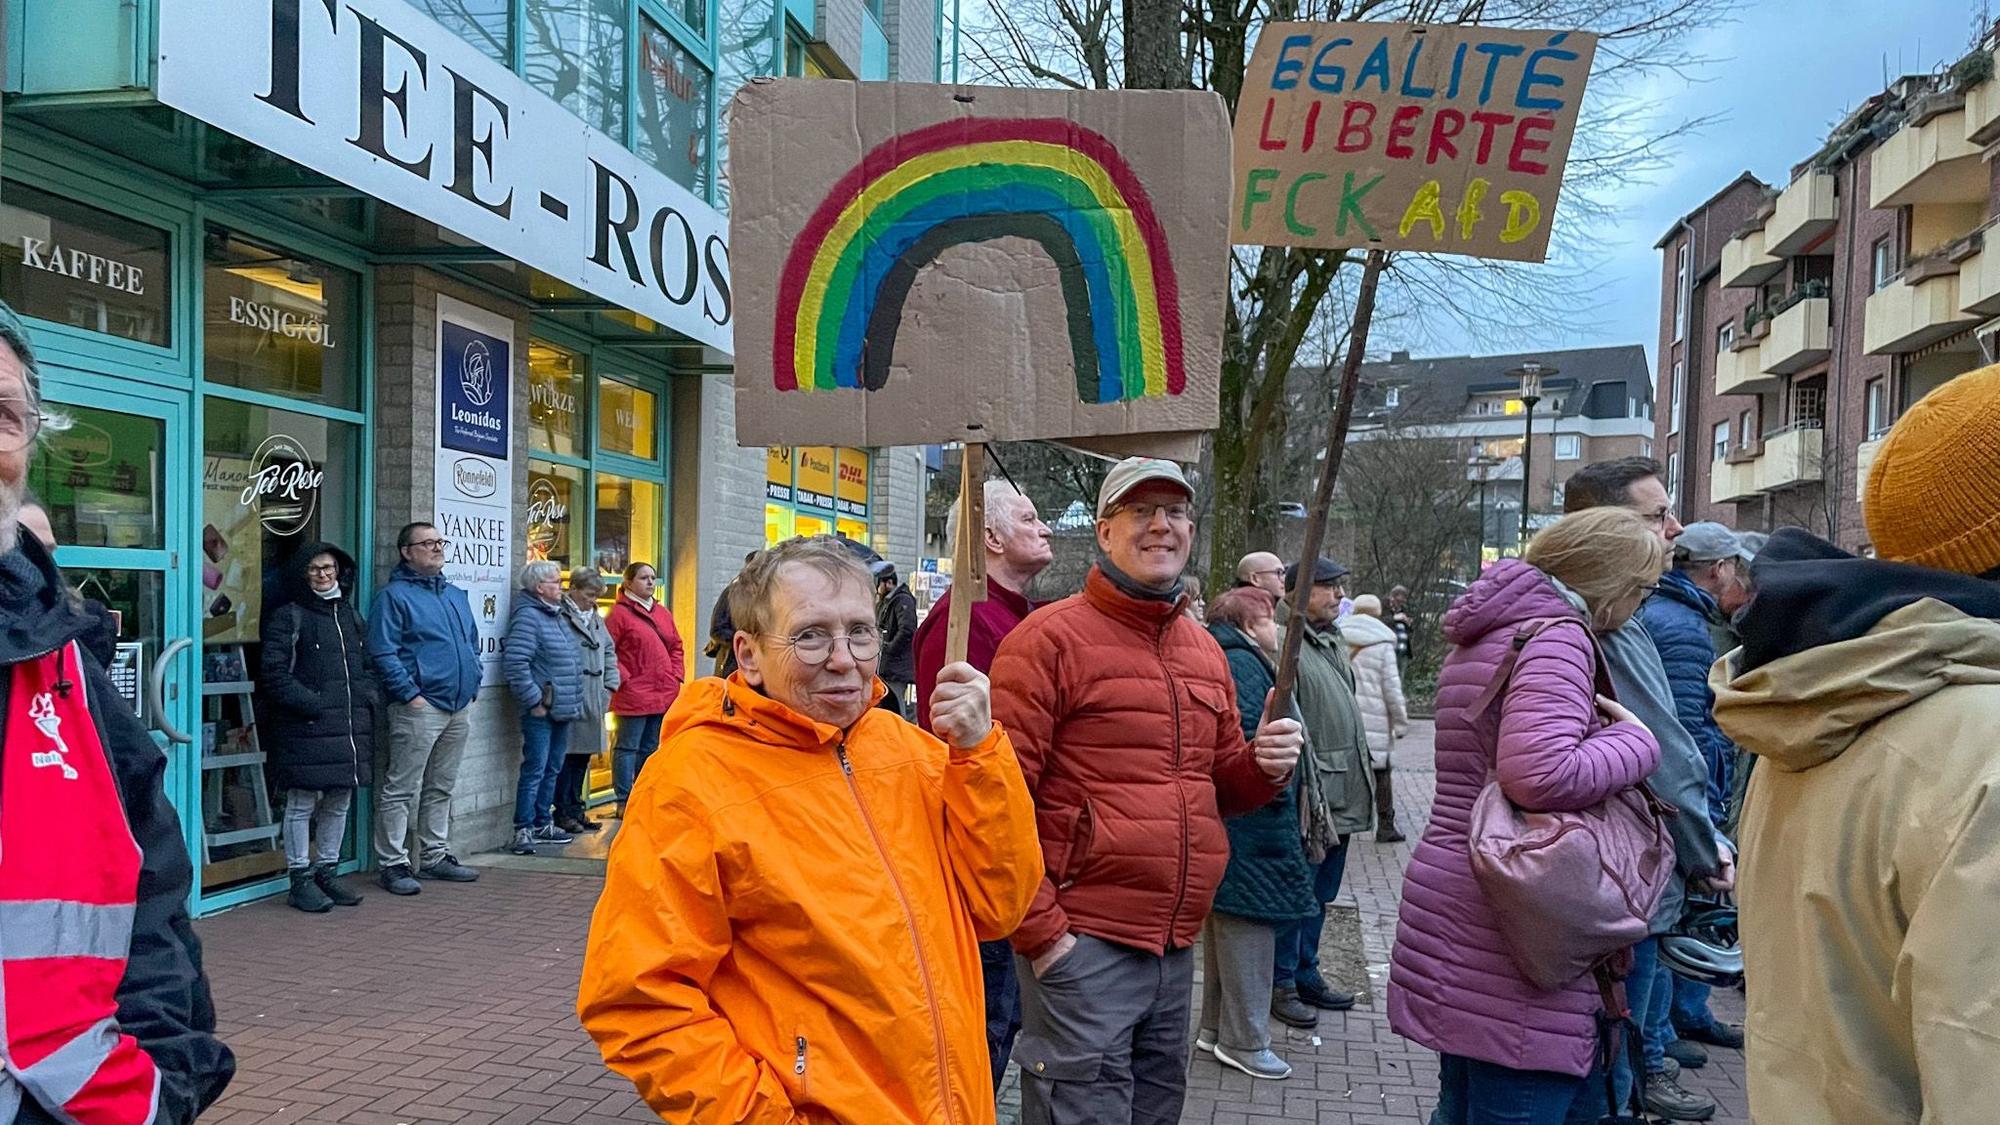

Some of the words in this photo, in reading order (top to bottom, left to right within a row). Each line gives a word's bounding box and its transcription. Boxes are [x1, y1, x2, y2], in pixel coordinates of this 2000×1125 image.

[1241, 168, 1385, 242] FCK
[1399, 177, 1541, 243] AfD
[21, 235, 144, 295] KAFFEE
[229, 296, 336, 348] ESSIG/ÖL
[452, 402, 502, 431] Leonidas
[440, 512, 504, 541] YANKEE
